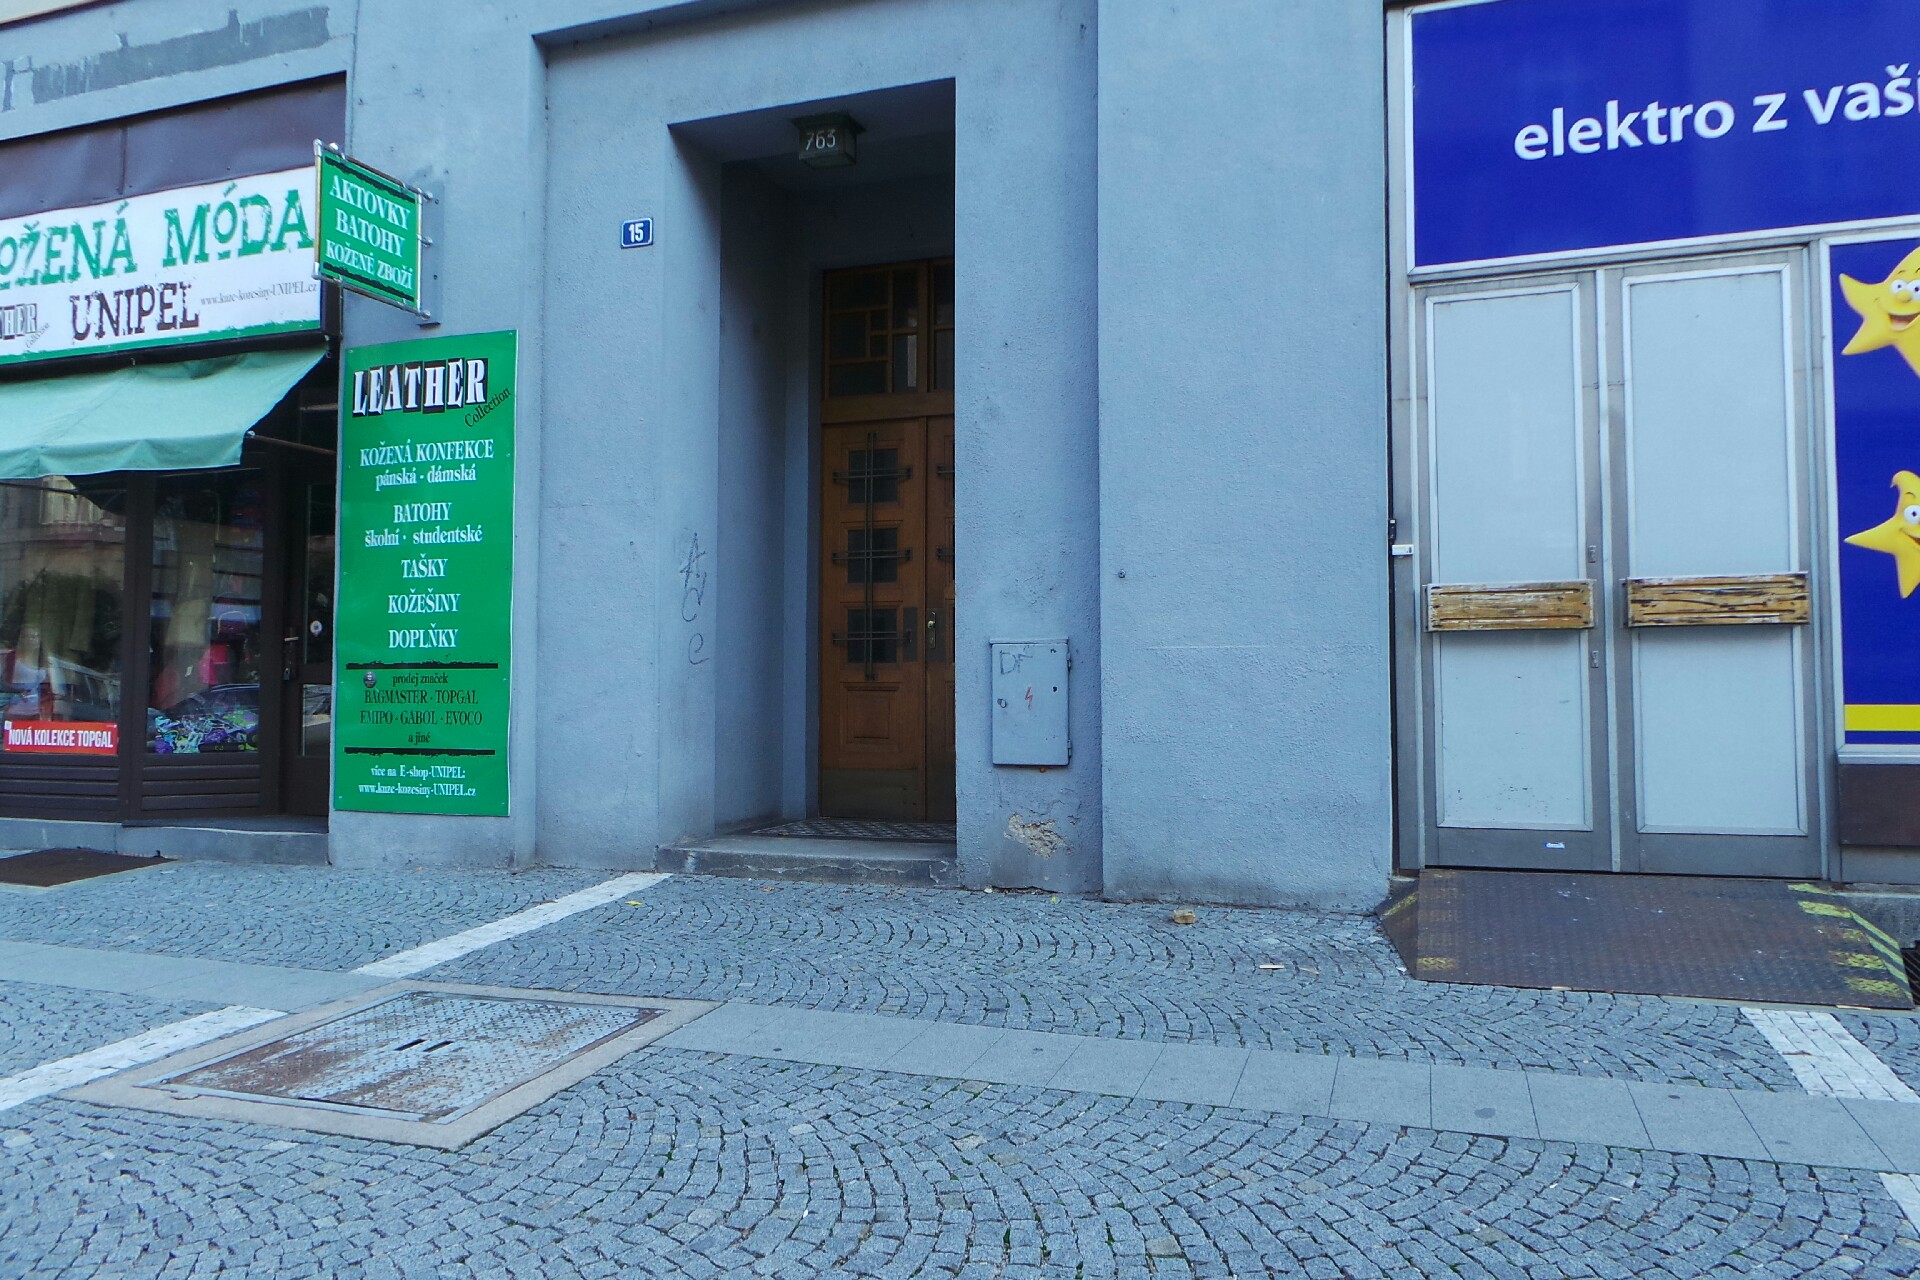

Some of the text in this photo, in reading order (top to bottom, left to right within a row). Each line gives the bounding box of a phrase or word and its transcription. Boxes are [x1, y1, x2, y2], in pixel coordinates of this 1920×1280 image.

[805, 128, 836, 151] 763
[1513, 99, 1736, 161] elektro
[1752, 92, 1789, 133] z
[330, 175, 411, 230] AKTOVKY
[162, 182, 315, 268] MÓDA
[335, 208, 405, 258] BATOHY
[628, 222, 645, 243] 15
[325, 239, 413, 290] KOŽENÉ ZBOŽÍ
[69, 282, 200, 341] UNIPEL
[352, 358, 487, 416] LEATHER
[464, 387, 511, 428] Collection
[360, 438, 494, 467] KOŽENÁ KONFEKCE
[375, 463, 477, 491] pánská dámská
[393, 502, 452, 523] BATOHY
[364, 525, 483, 547] školní studentské
[401, 553, 448, 578] TAŠKY
[388, 588, 461, 614] KOŽEŠINY
[389, 623, 459, 649] DOPLŇKY
[392, 671, 449, 687] prodej značek
[364, 690, 479, 705] BAGMASTER TOPGAL
[400, 710, 438, 725] GABOL
[445, 711, 483, 725] EVOCO
[8, 726, 113, 748] NOVÁ KOLEKCE TOPGAL
[415, 731, 431, 746] jiné
[371, 765, 386, 777] více
[387, 767, 397, 777] na
